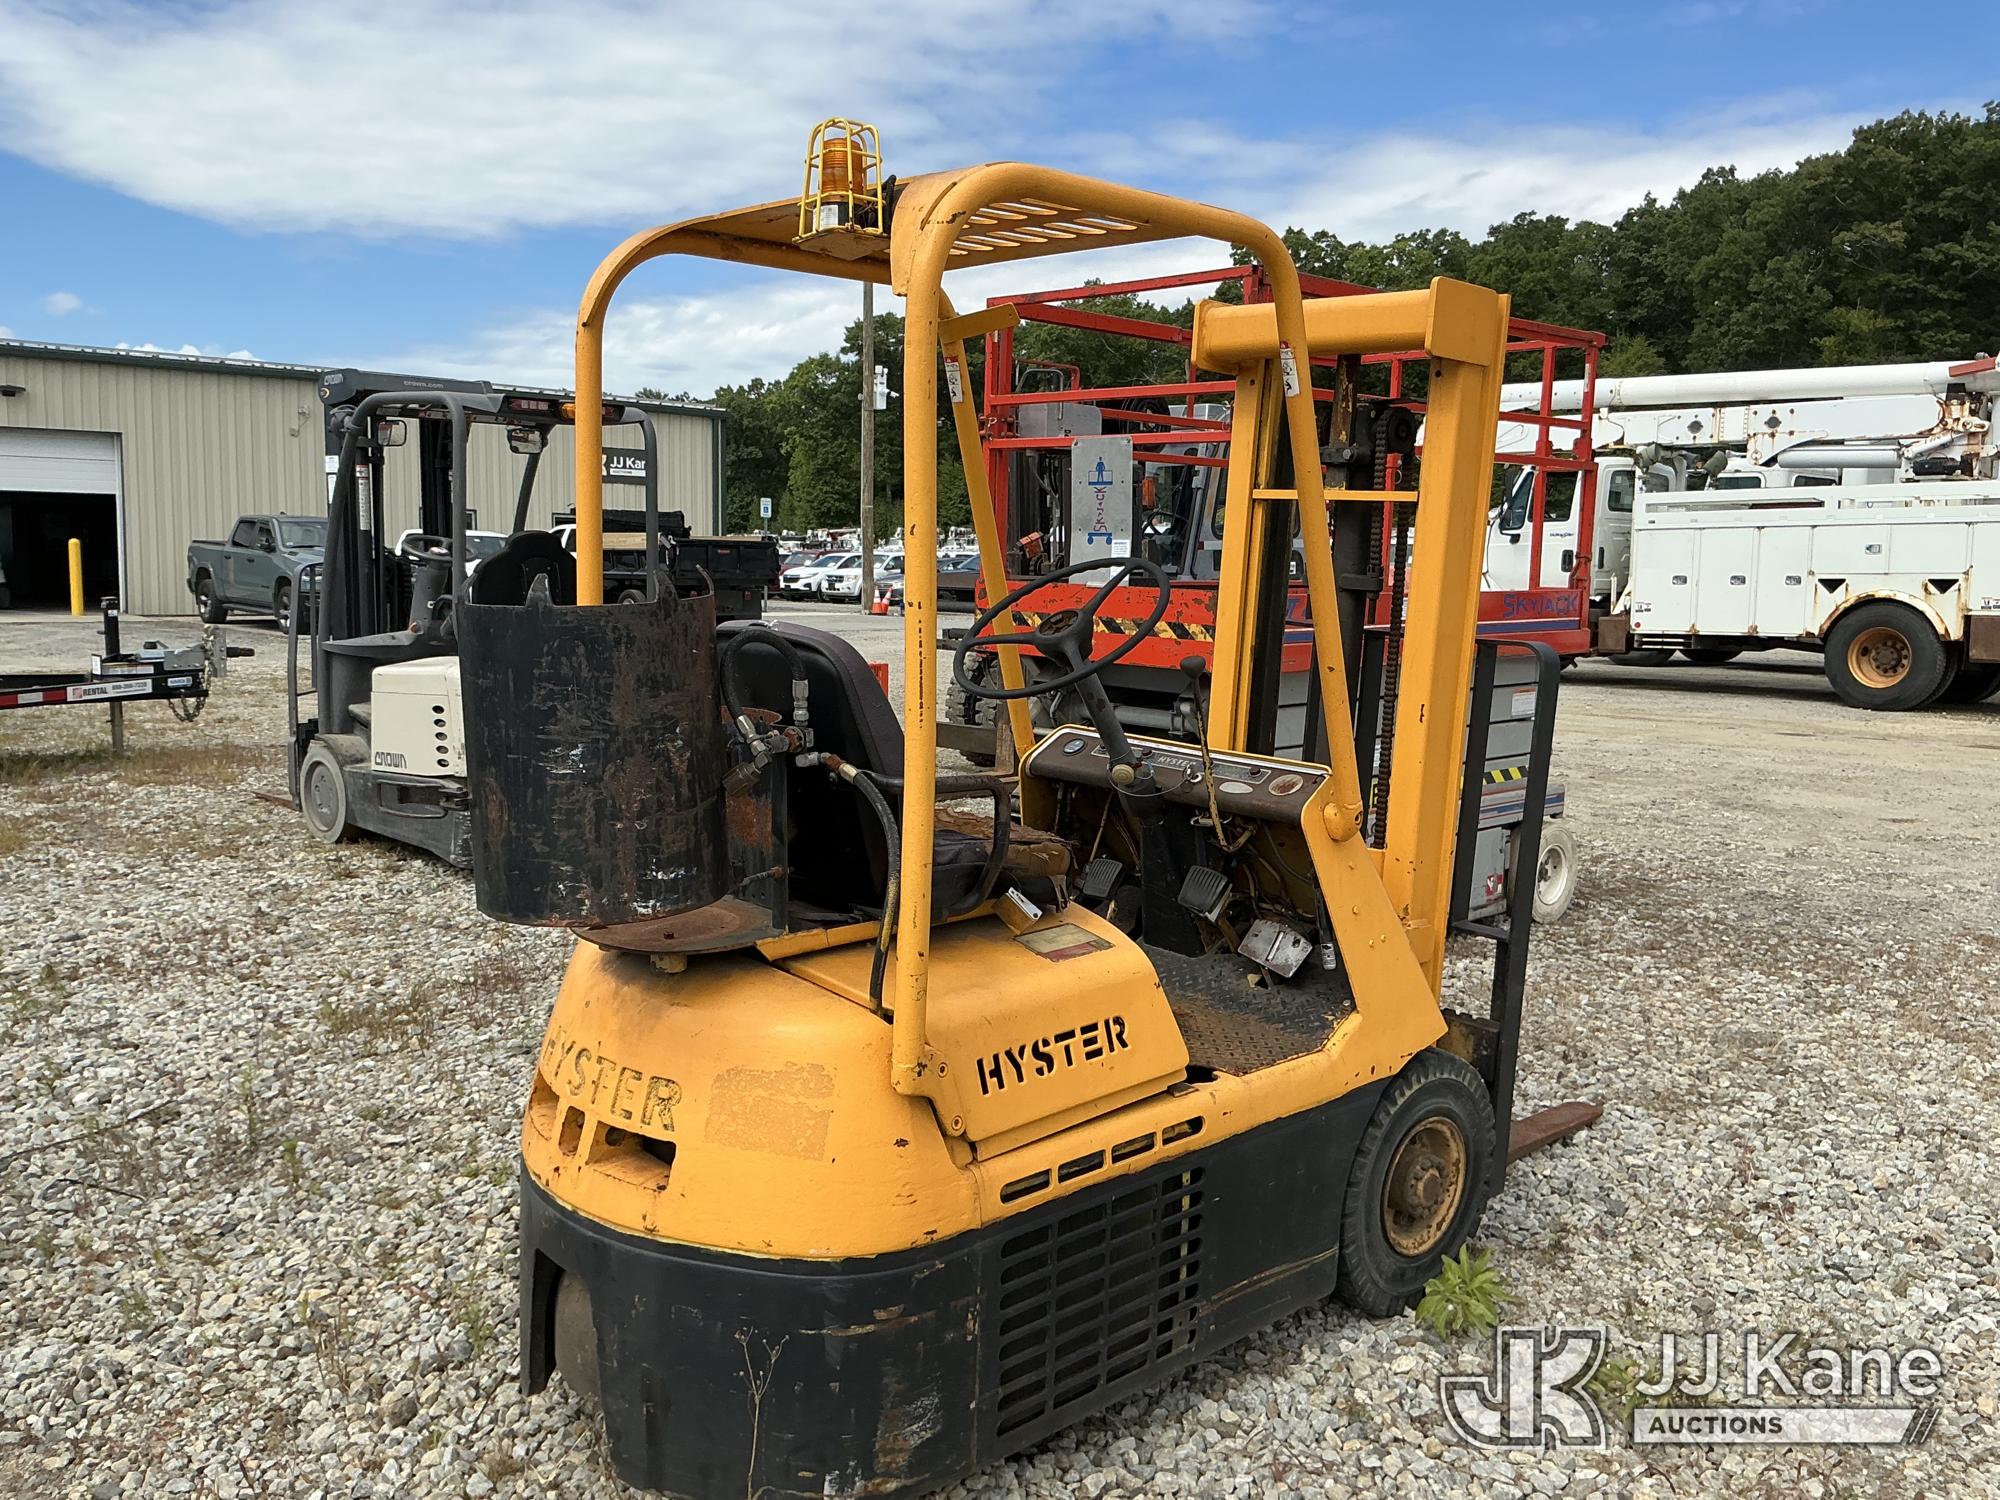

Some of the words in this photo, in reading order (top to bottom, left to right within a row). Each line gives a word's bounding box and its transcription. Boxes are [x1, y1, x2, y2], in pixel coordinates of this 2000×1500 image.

[610, 456, 624, 468] JJ
[541, 1027, 683, 1132] HYSTER
[976, 1015, 1129, 1096] HYSTER
